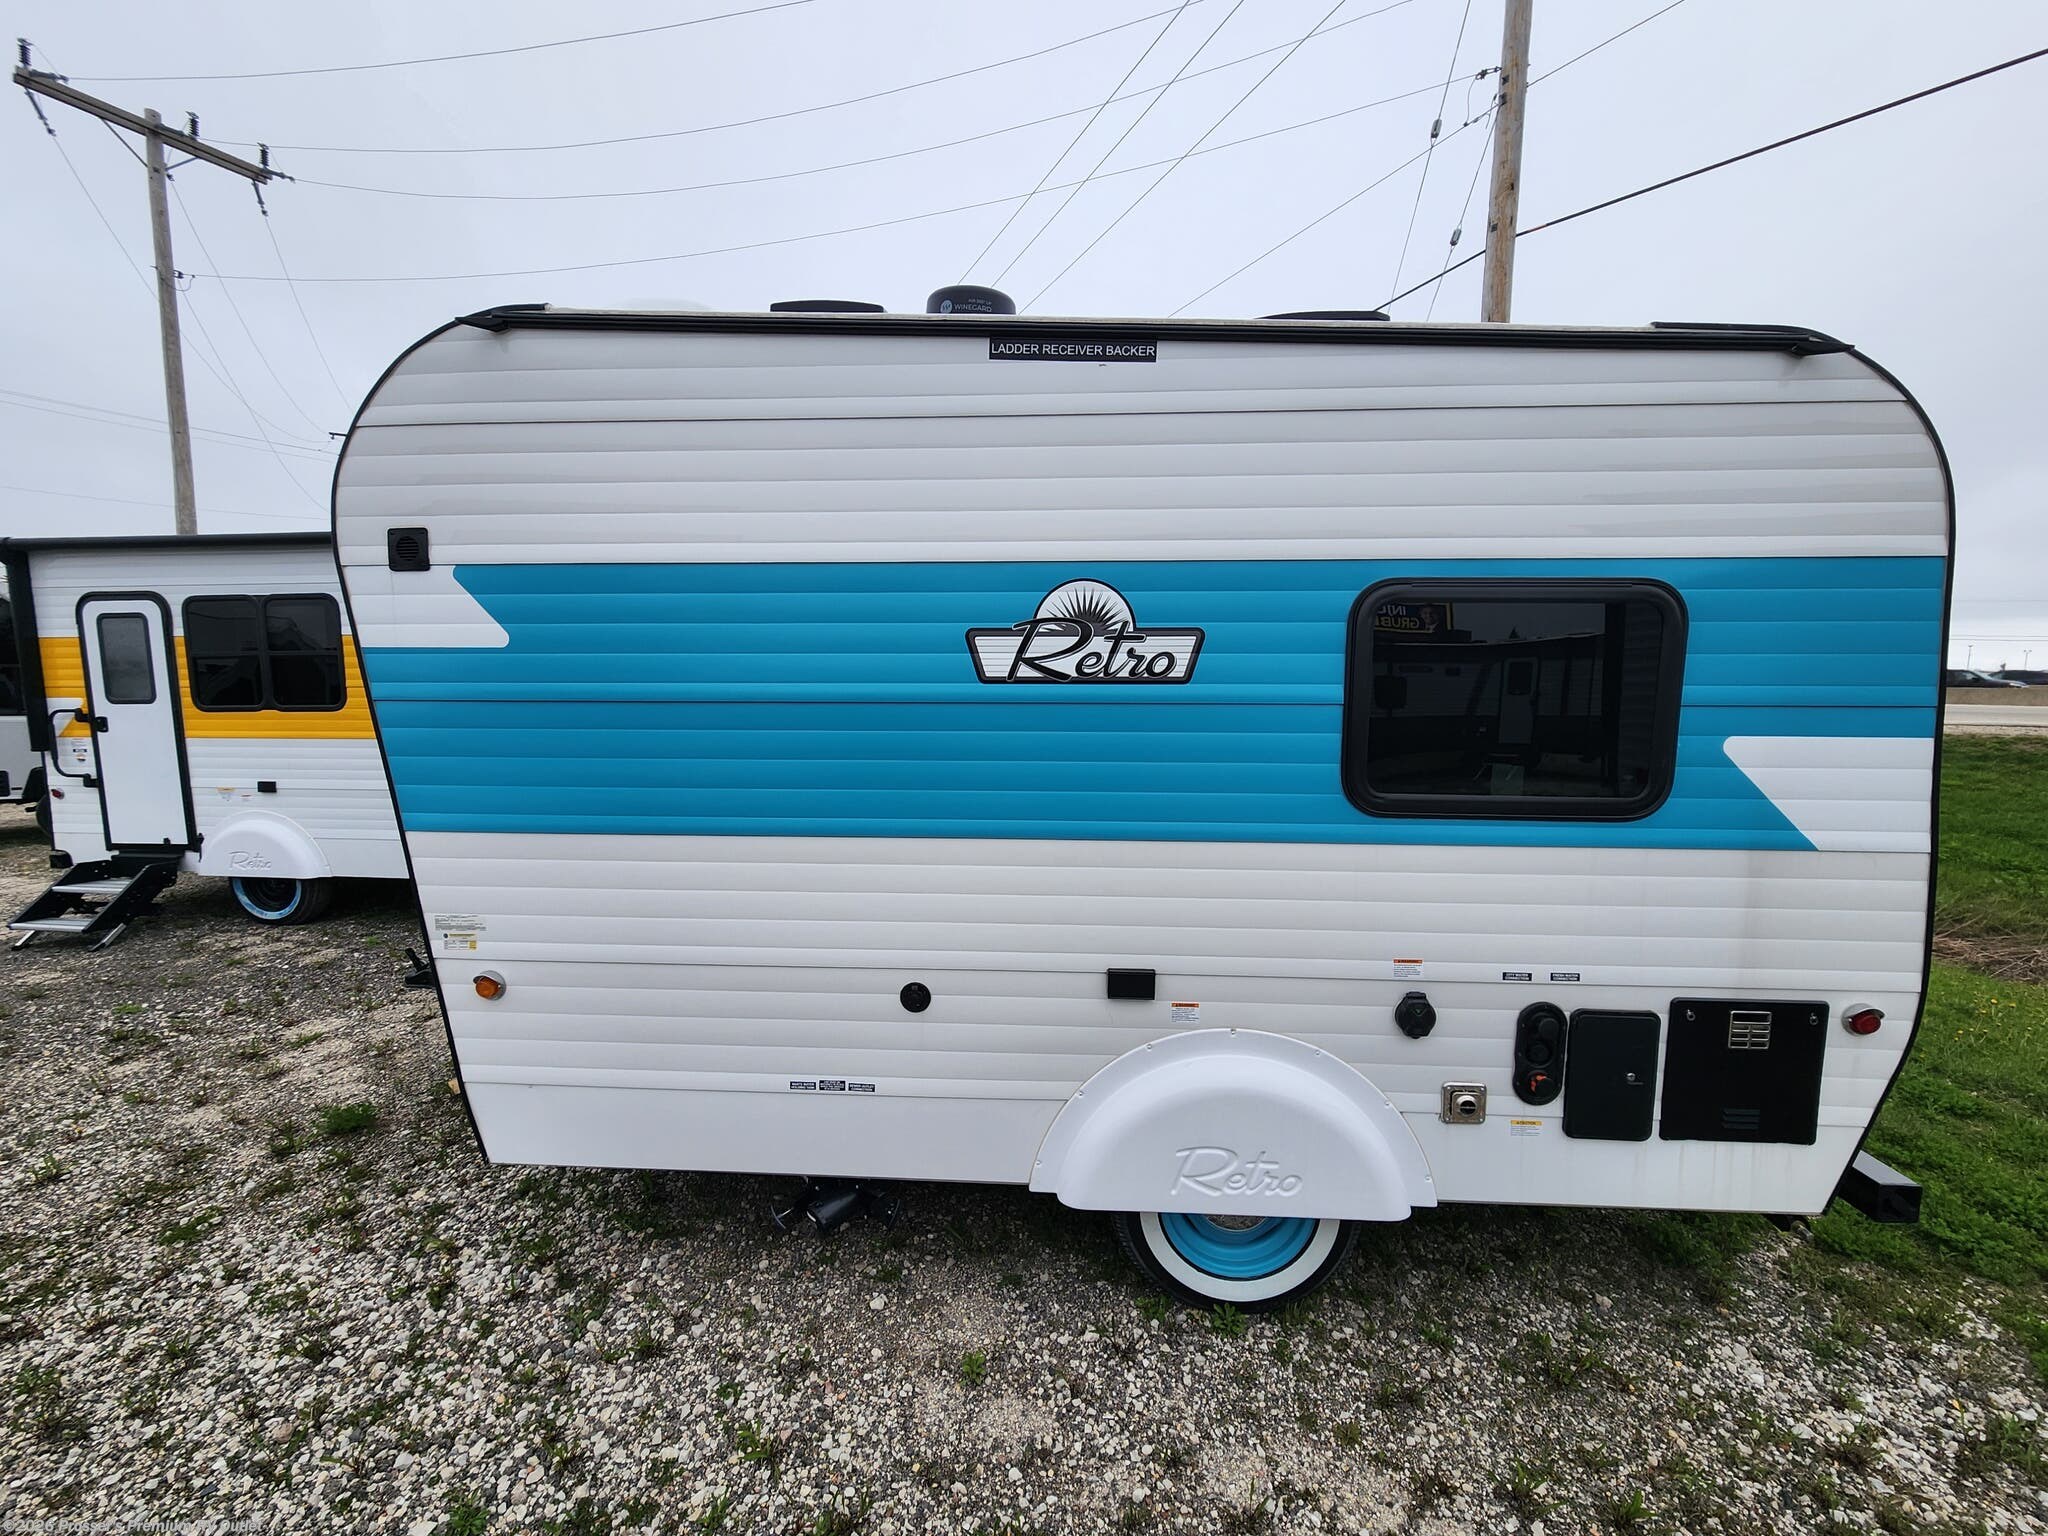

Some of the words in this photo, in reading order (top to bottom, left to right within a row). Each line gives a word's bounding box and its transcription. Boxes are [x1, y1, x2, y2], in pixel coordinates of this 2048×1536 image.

[954, 303, 992, 313] WINEGARD
[991, 343, 1039, 355] LADDER
[1042, 344, 1103, 356] RECEIVER
[1106, 345, 1155, 357] BACKER
[1006, 617, 1177, 682] Retro
[228, 850, 272, 870] Retro
[1170, 1146, 1303, 1197] Retro
